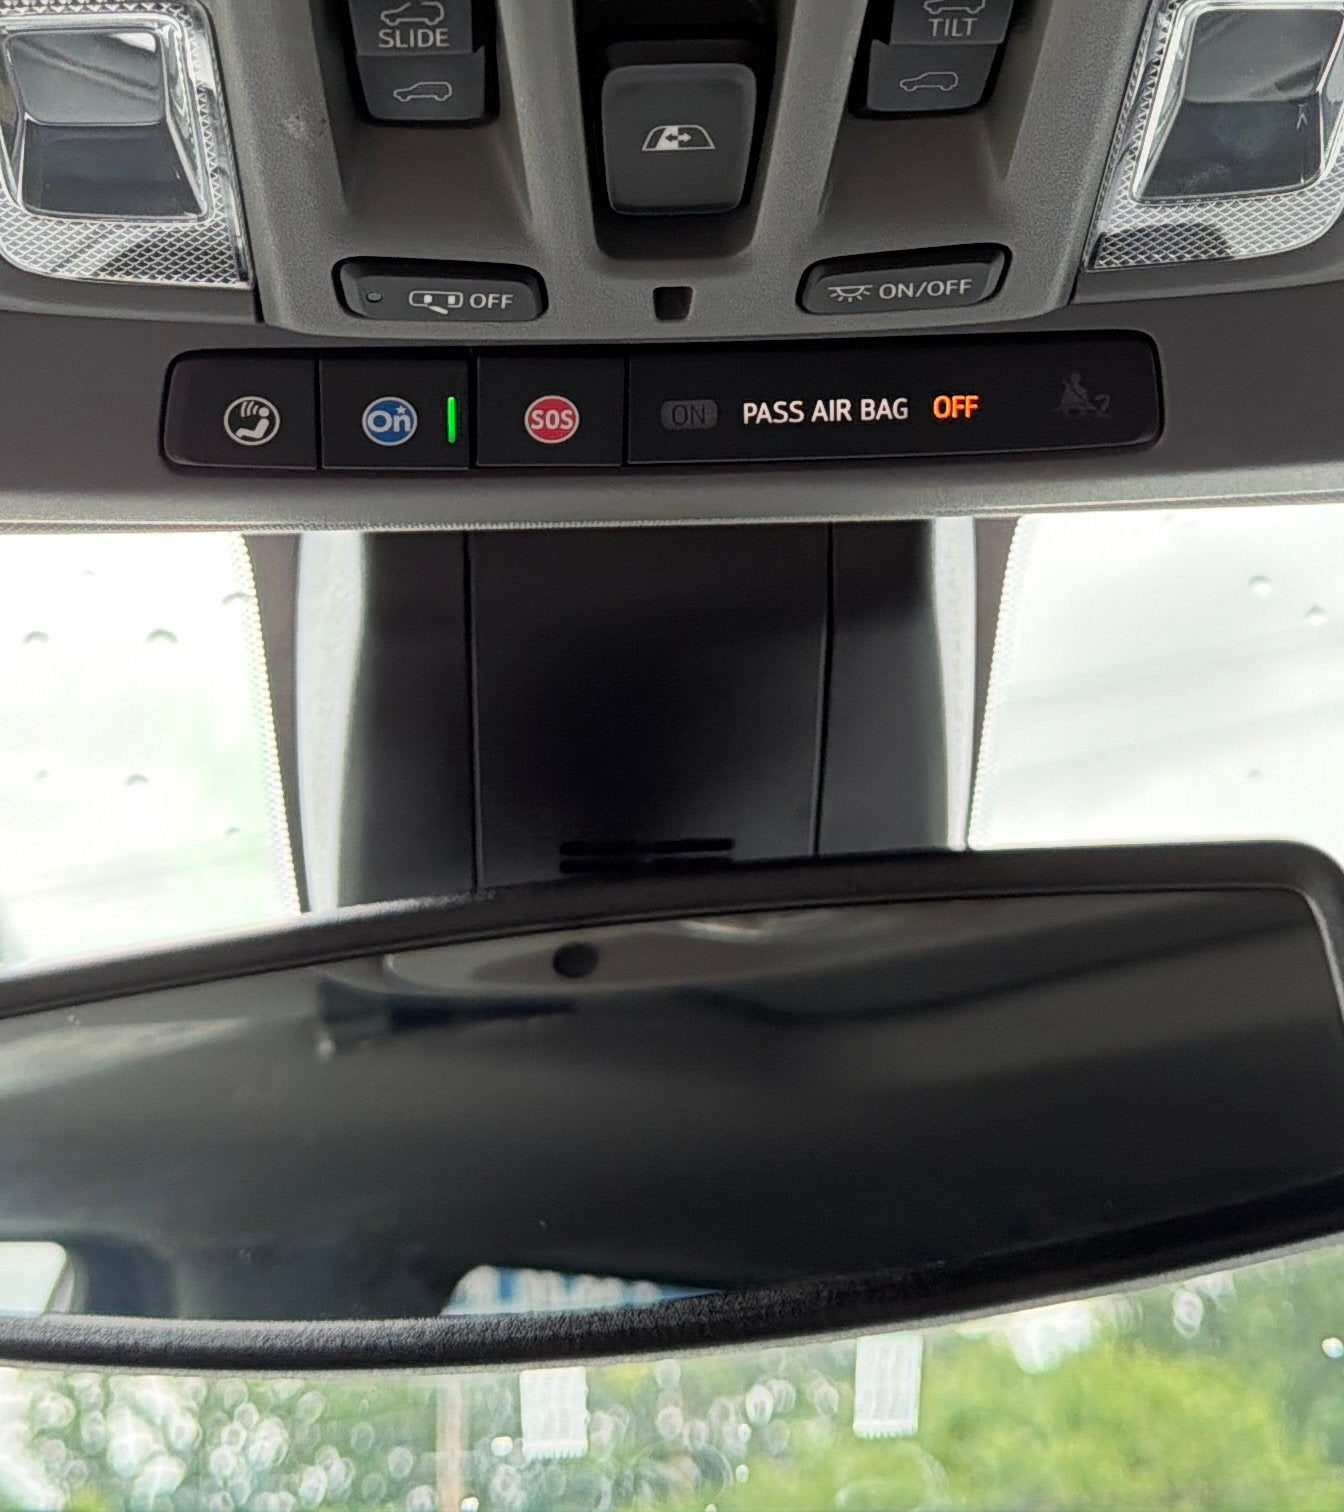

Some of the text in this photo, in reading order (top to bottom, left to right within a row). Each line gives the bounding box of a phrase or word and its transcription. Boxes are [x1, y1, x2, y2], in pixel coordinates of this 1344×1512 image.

[377, 27, 450, 49] SLIDE
[928, 17, 979, 38] TILT
[878, 278, 974, 301] ON/OFF
[468, 292, 515, 311] OFF
[530, 407, 574, 431] SOS
[672, 403, 706, 424] ON
[742, 394, 981, 426] PASS AIR BAG OFF
